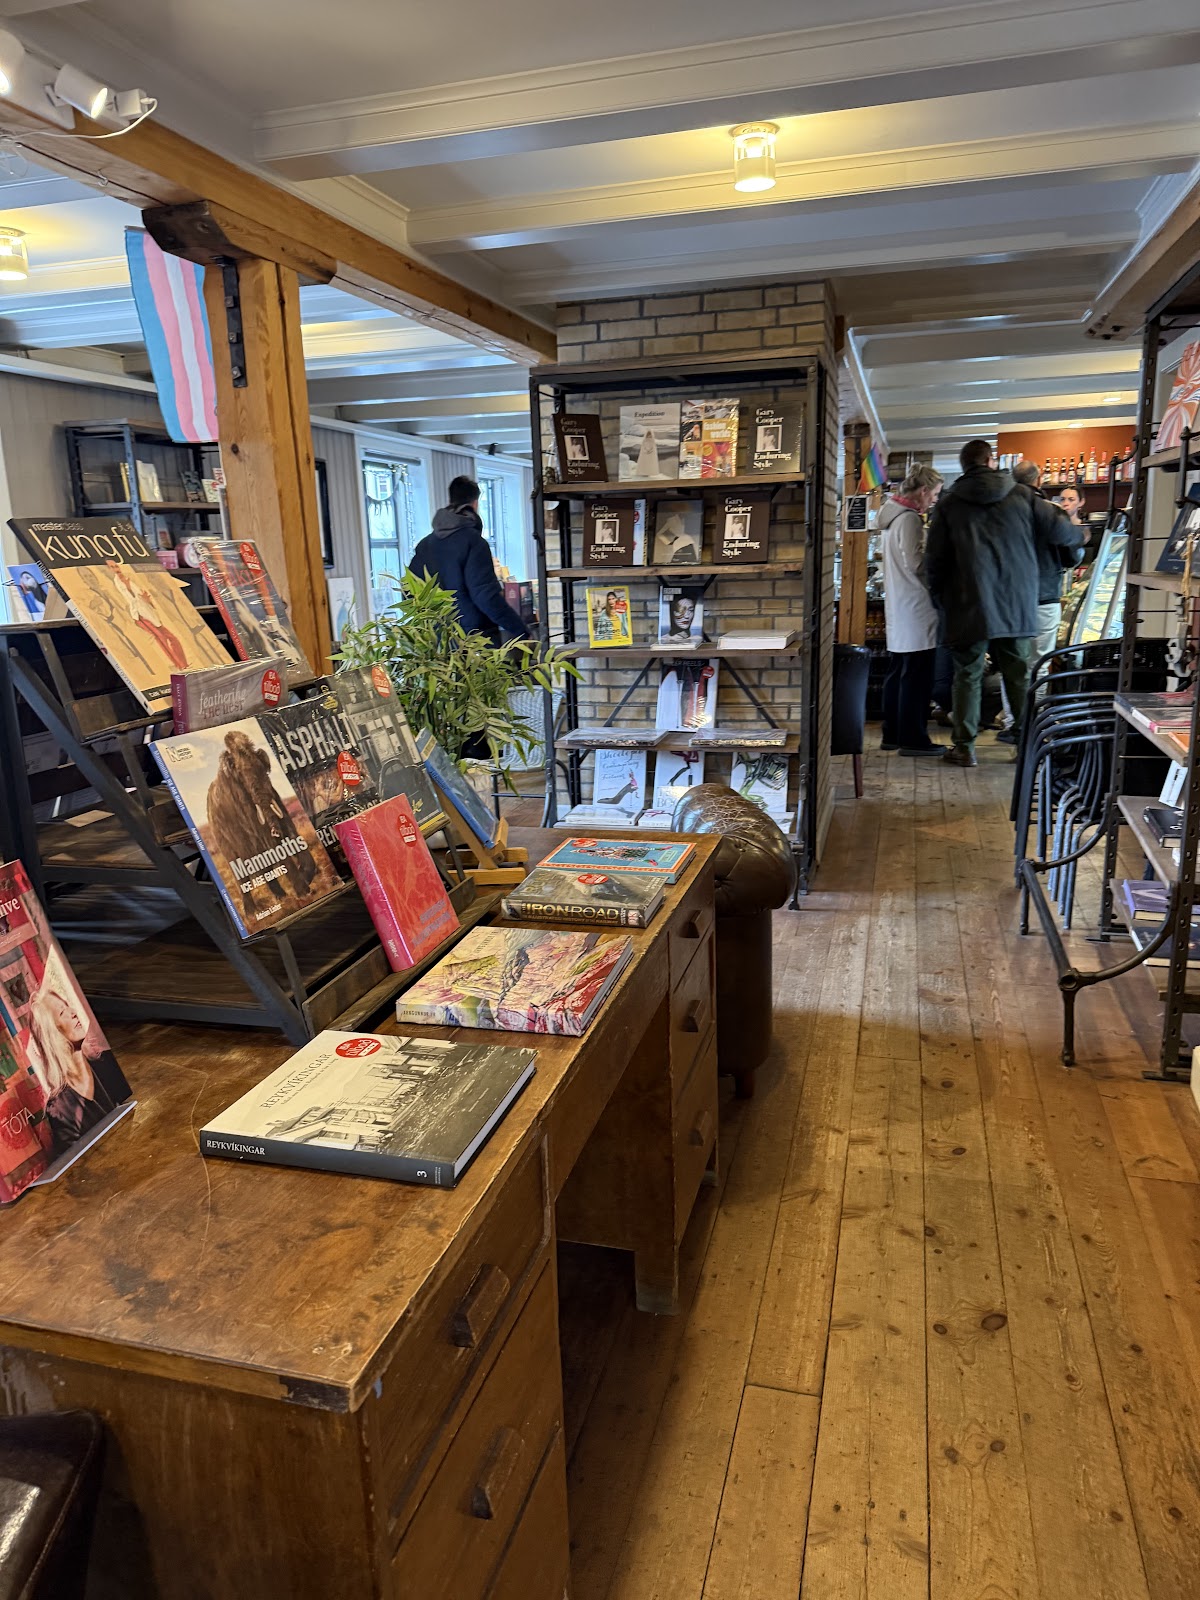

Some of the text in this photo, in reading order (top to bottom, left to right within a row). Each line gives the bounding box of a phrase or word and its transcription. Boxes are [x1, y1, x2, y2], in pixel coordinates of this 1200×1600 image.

[755, 408, 774, 417] Gary
[755, 415, 784, 424] Cooper
[561, 426, 586, 434] Cooper
[754, 451, 792, 461] Enduring
[753, 460, 772, 470] Style
[567, 468, 586, 477] Style
[725, 497, 744, 505] Gary
[591, 503, 609, 512] Gary
[724, 504, 753, 514] Cooper
[590, 511, 618, 520] Cooper
[28, 526, 150, 565] kung fu
[590, 544, 626, 553] Enduring
[722, 540, 760, 550] Enduring
[589, 553, 609, 561] Style
[722, 548, 742, 557] Style
[199, 681, 247, 715] feathering
[272, 712, 357, 774] ASPHALT
[229, 835, 308, 880] Mammoths
[240, 865, 288, 893] ICE AGE GIANTS
[255, 909, 271, 921] Adrian
[526, 903, 569, 917] IRON
[569, 906, 619, 919] ROAD
[259, 1053, 333, 1108] REYKVÍKINGAR
[2, 1107, 35, 1138] TÓTA
[206, 1140, 265, 1155] REYKVÍKINGAR
[416, 1170, 428, 1178] 3
